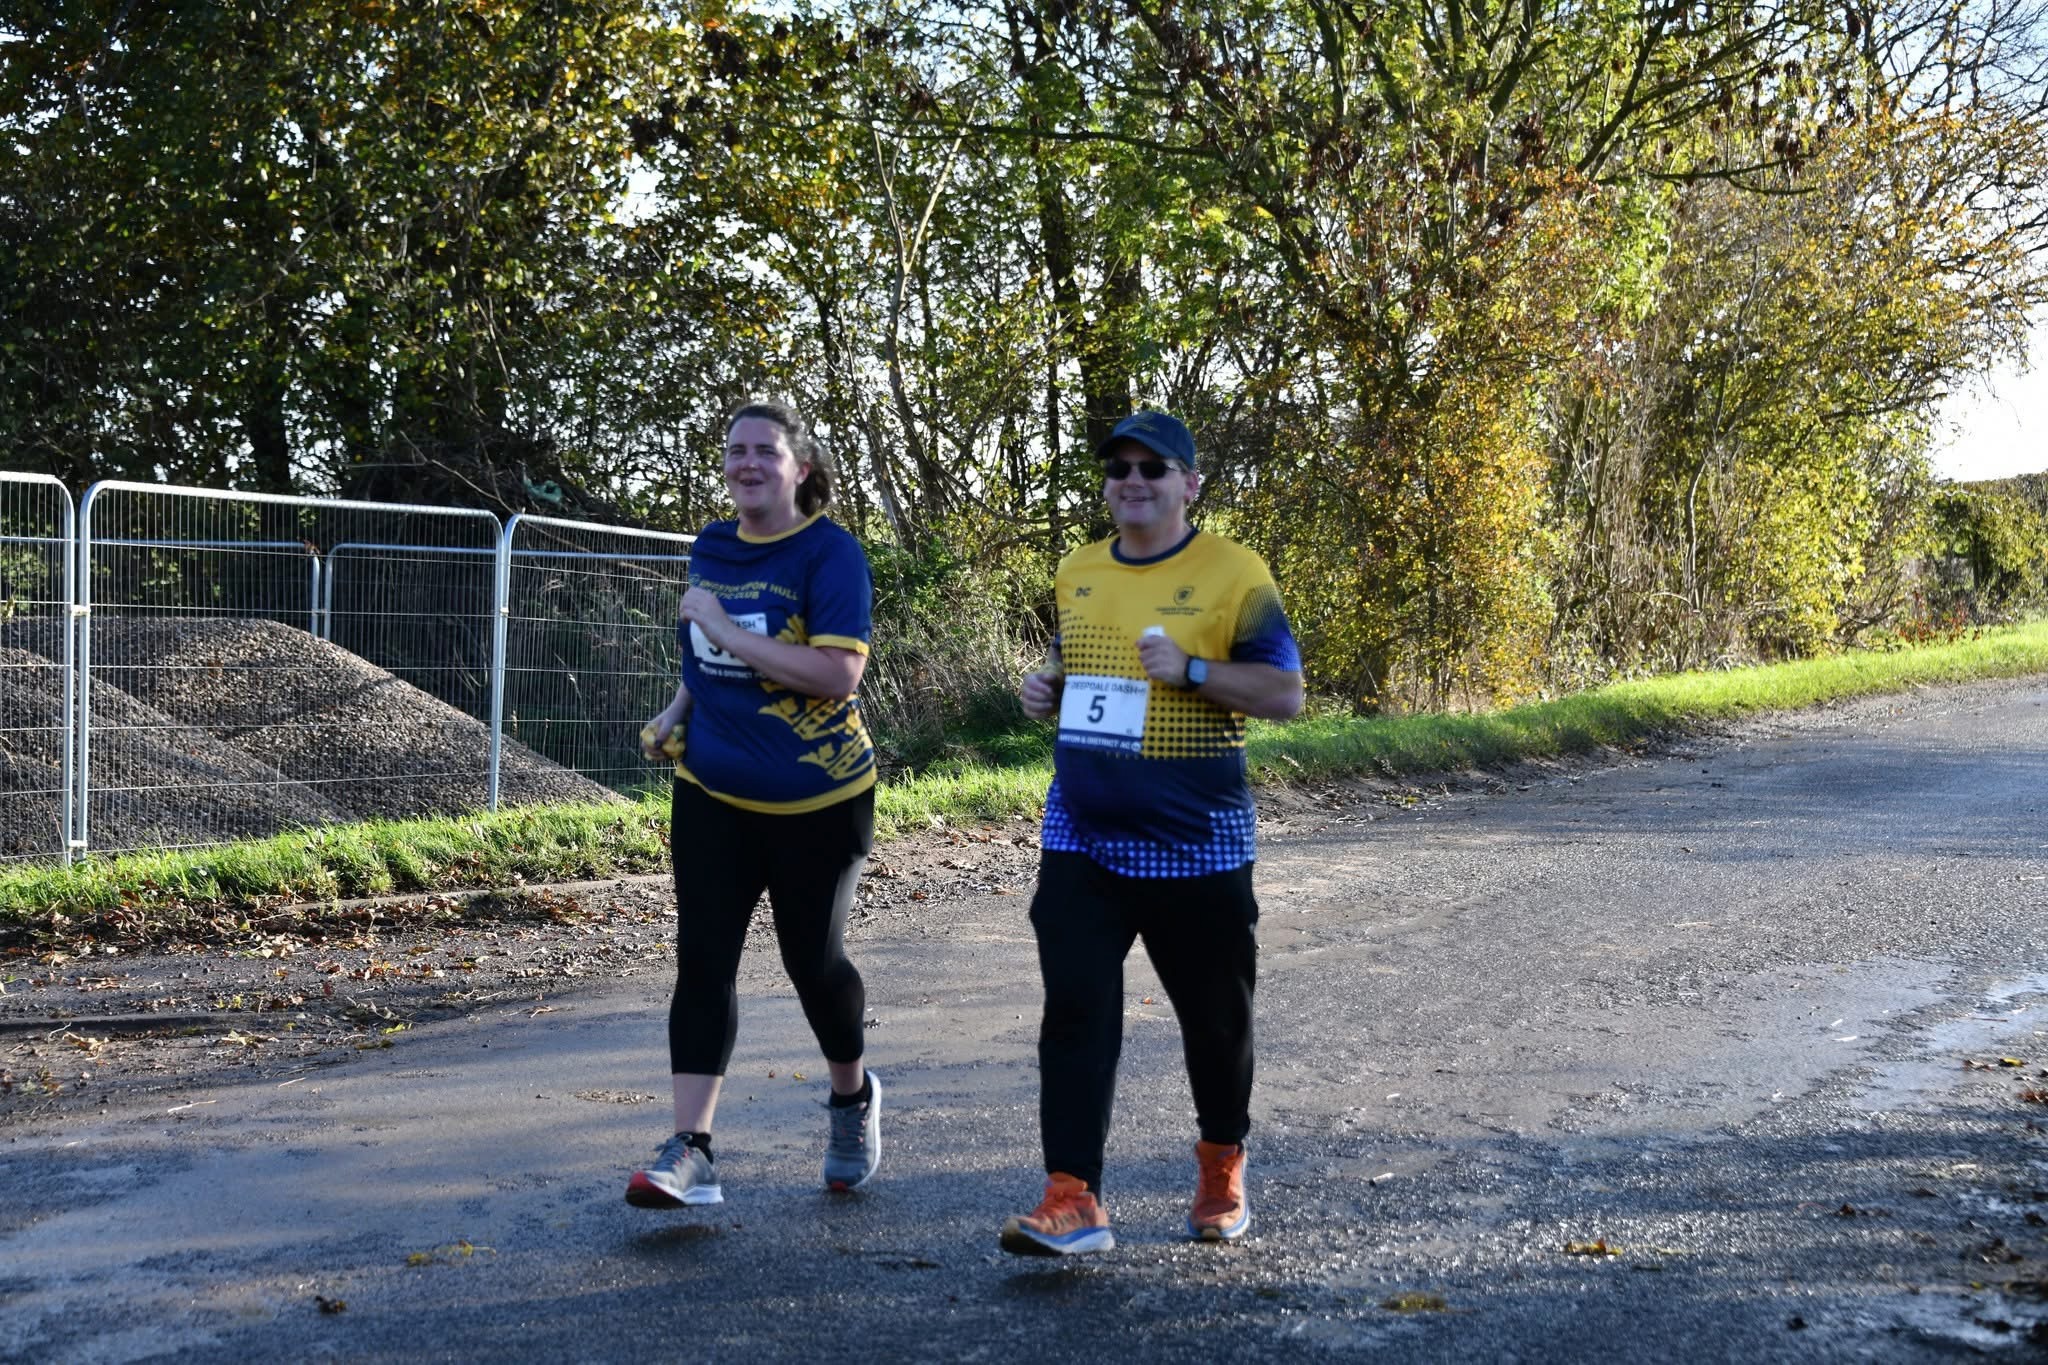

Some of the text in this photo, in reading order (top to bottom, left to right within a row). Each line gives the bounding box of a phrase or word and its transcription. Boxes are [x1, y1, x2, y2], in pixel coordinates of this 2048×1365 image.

[735, 591, 760, 600] CLUB
[769, 584, 799, 601] HULL
[1070, 681, 1137, 695] DEEPDALE DASH
[1087, 695, 1106, 724] 5
